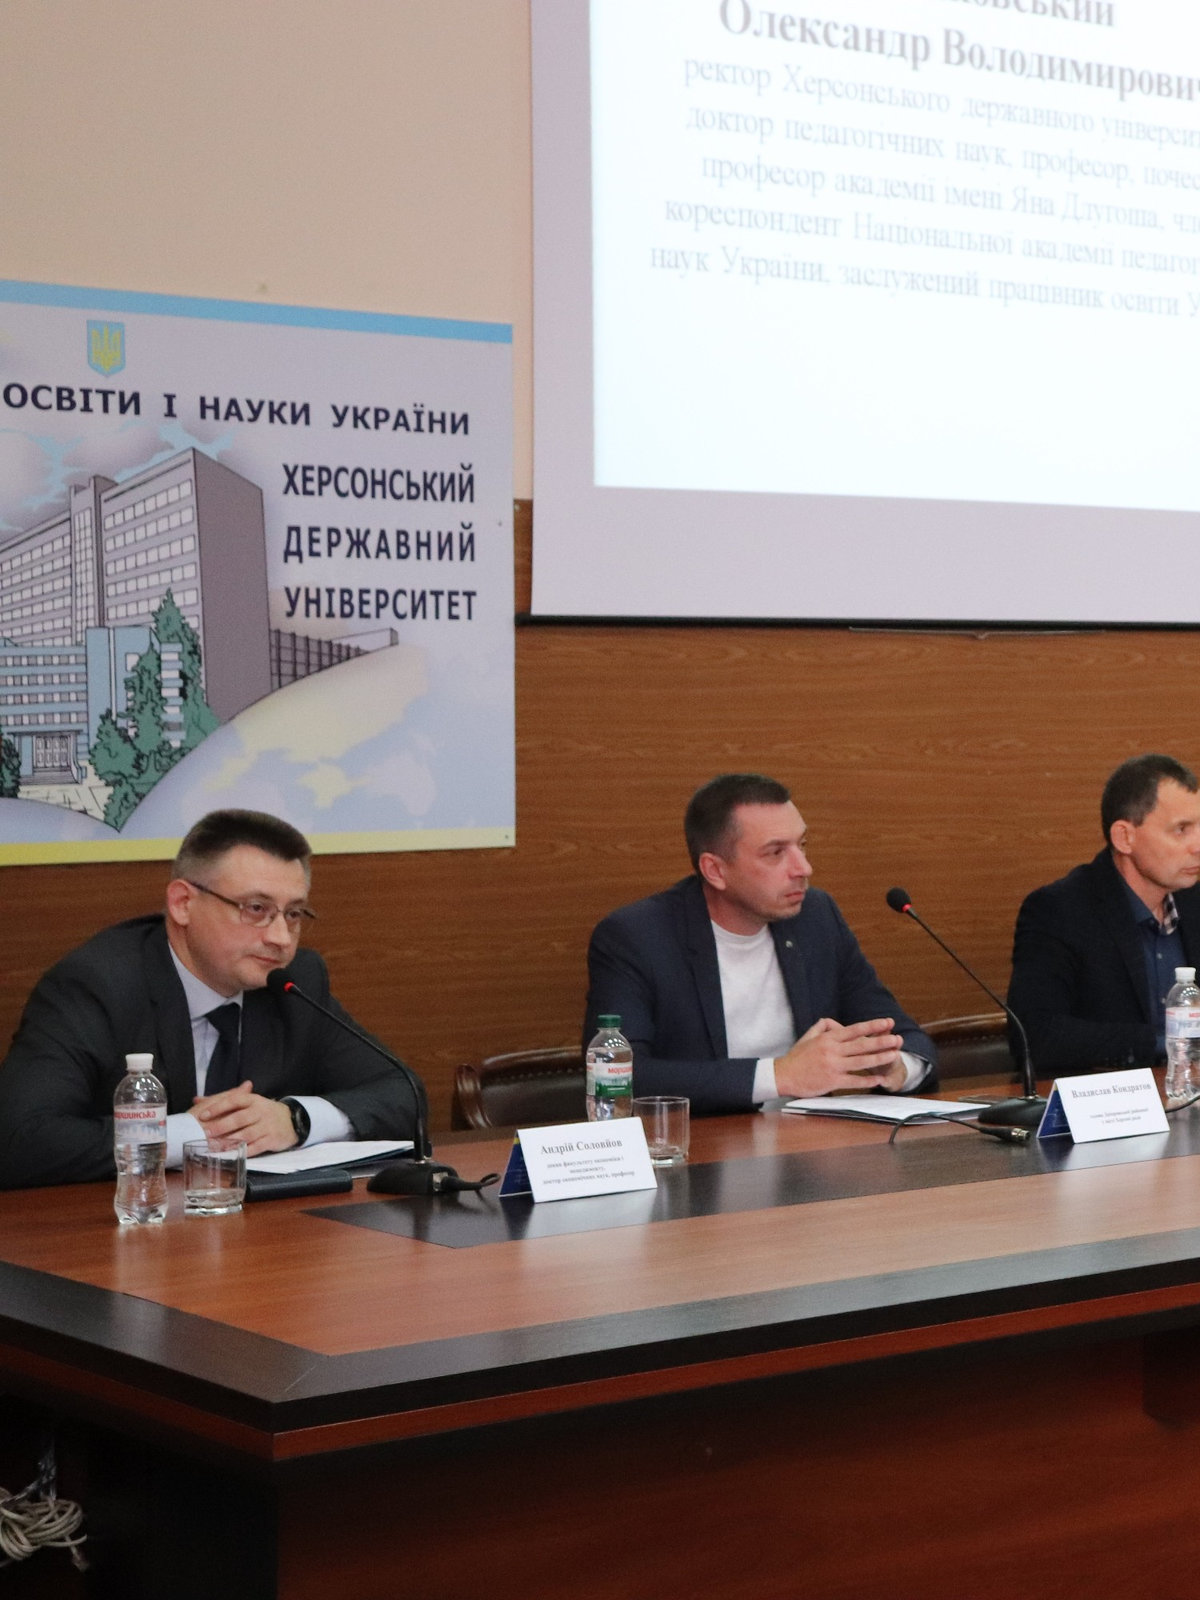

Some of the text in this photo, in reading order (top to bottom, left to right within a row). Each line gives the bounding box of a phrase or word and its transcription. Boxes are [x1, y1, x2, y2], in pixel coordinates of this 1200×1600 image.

[719, 0, 930, 70] Олександр
[684, 57, 771, 95] ректор
[783, 64, 951, 113] Херсонського
[960, 97, 1094, 132] державного
[686, 106, 774, 145] доктор
[784, 117, 945, 159] педагогічних
[955, 139, 1013, 171] наук,
[1022, 147, 1135, 188] професор,
[702, 153, 826, 197] професор
[834, 173, 936, 204] академії
[944, 176, 1003, 210] імені
[1011, 186, 1055, 217] Яна
[1061, 191, 1165, 231] Длугоша,
[664, 199, 843, 238] кореспондент
[852, 210, 1013, 256] Національної
[1021, 236, 1114, 267] академії
[650, 246, 710, 278] наук
[720, 245, 831, 285] України,
[839, 263, 979, 298] заслужений
[988, 276, 1104, 309] працівник
[1111, 291, 1179, 317] освіти
[2, 382, 470, 436] ОСВІТИ І НАУКИ УКРАЇНИ
[282, 462, 476, 504] ХЕРСОНСЬКИЙ
[283, 523, 477, 565] ДЕРЖАВНИЙ
[284, 585, 477, 621] УНІВЕРСИТЕТ
[541, 1139, 623, 1156] Андрій Соловйов
